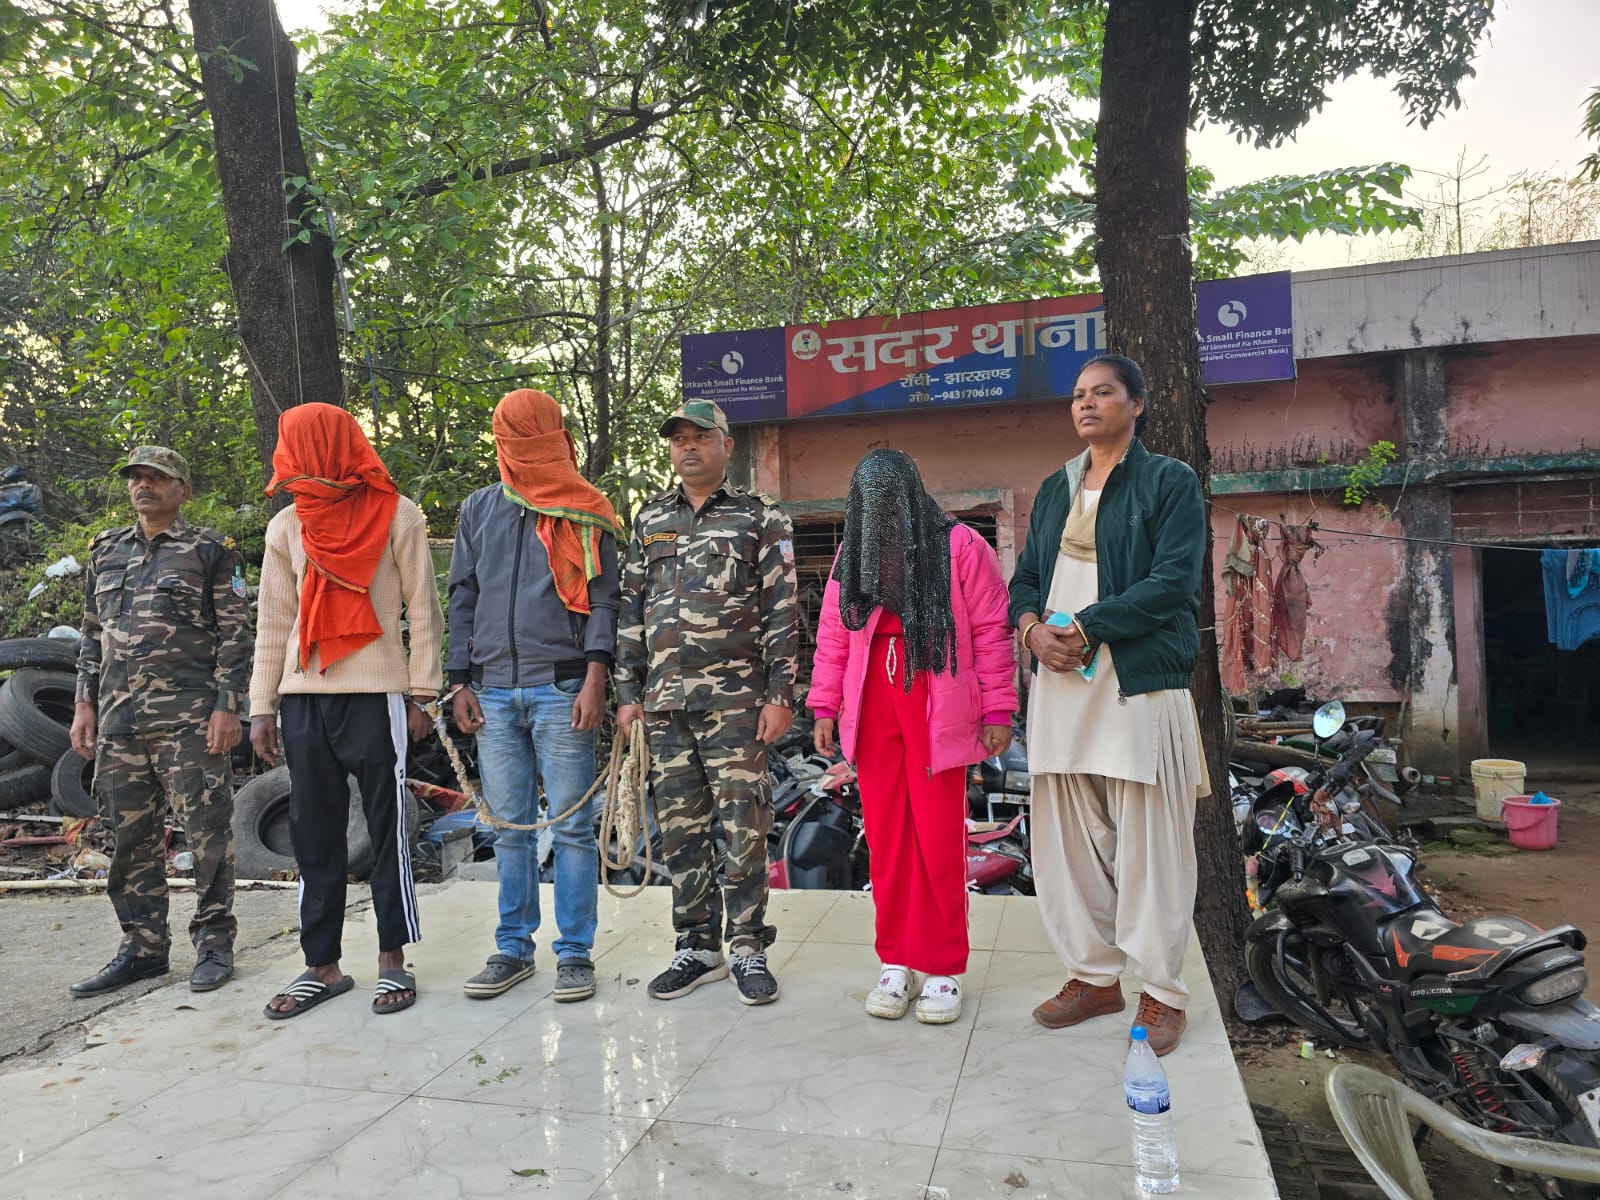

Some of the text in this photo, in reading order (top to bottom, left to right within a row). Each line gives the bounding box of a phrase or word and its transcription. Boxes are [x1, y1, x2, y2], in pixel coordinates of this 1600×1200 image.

[825, 310, 1107, 373] सदर थाना
[1206, 332, 1233, 343] Small
[1235, 329, 1273, 340] Finance
[1225, 348, 1267, 359] Commercial
[1268, 347, 1288, 355] Bank)
[683, 374, 784, 388] Utkarsh Small Finance Bank
[943, 368, 1012, 385] झारखण्ड
